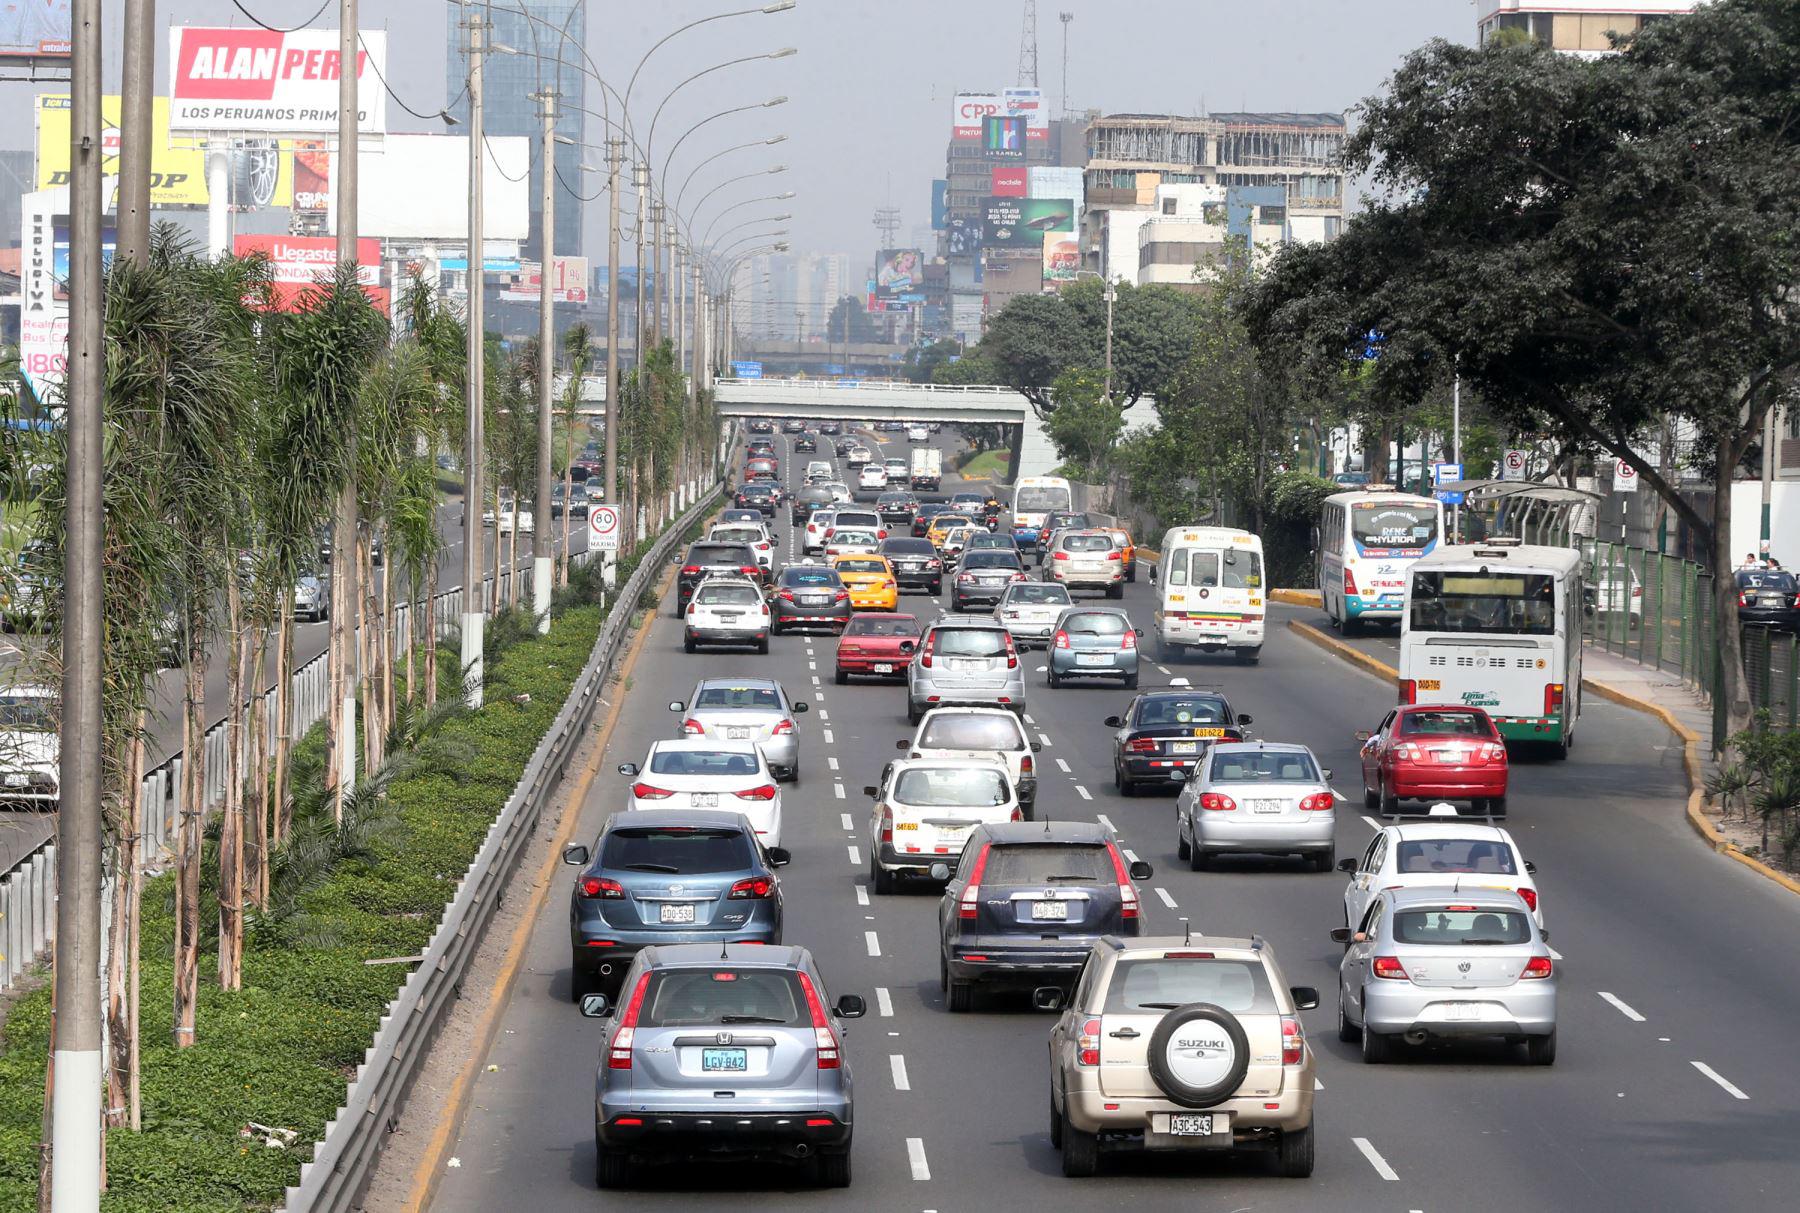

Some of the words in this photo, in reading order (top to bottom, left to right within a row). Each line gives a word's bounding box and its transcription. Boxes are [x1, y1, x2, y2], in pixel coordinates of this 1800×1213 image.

[188, 46, 277, 80] ALAN
[181, 107, 210, 119] LOS
[213, 107, 295, 121] PERUANOS
[961, 104, 997, 119] CPP
[24, 334, 45, 343] Bus
[596, 513, 612, 524] 80
[1382, 527, 1408, 536] RENE
[1374, 536, 1416, 544] HYUNDAI
[1462, 692, 1486, 700] Lima
[1465, 699, 1501, 707] Express
[1177, 1040, 1226, 1049] SUZUKI
[705, 1056, 745, 1068] LGV-842
[1172, 1119, 1212, 1132] A3C-543
